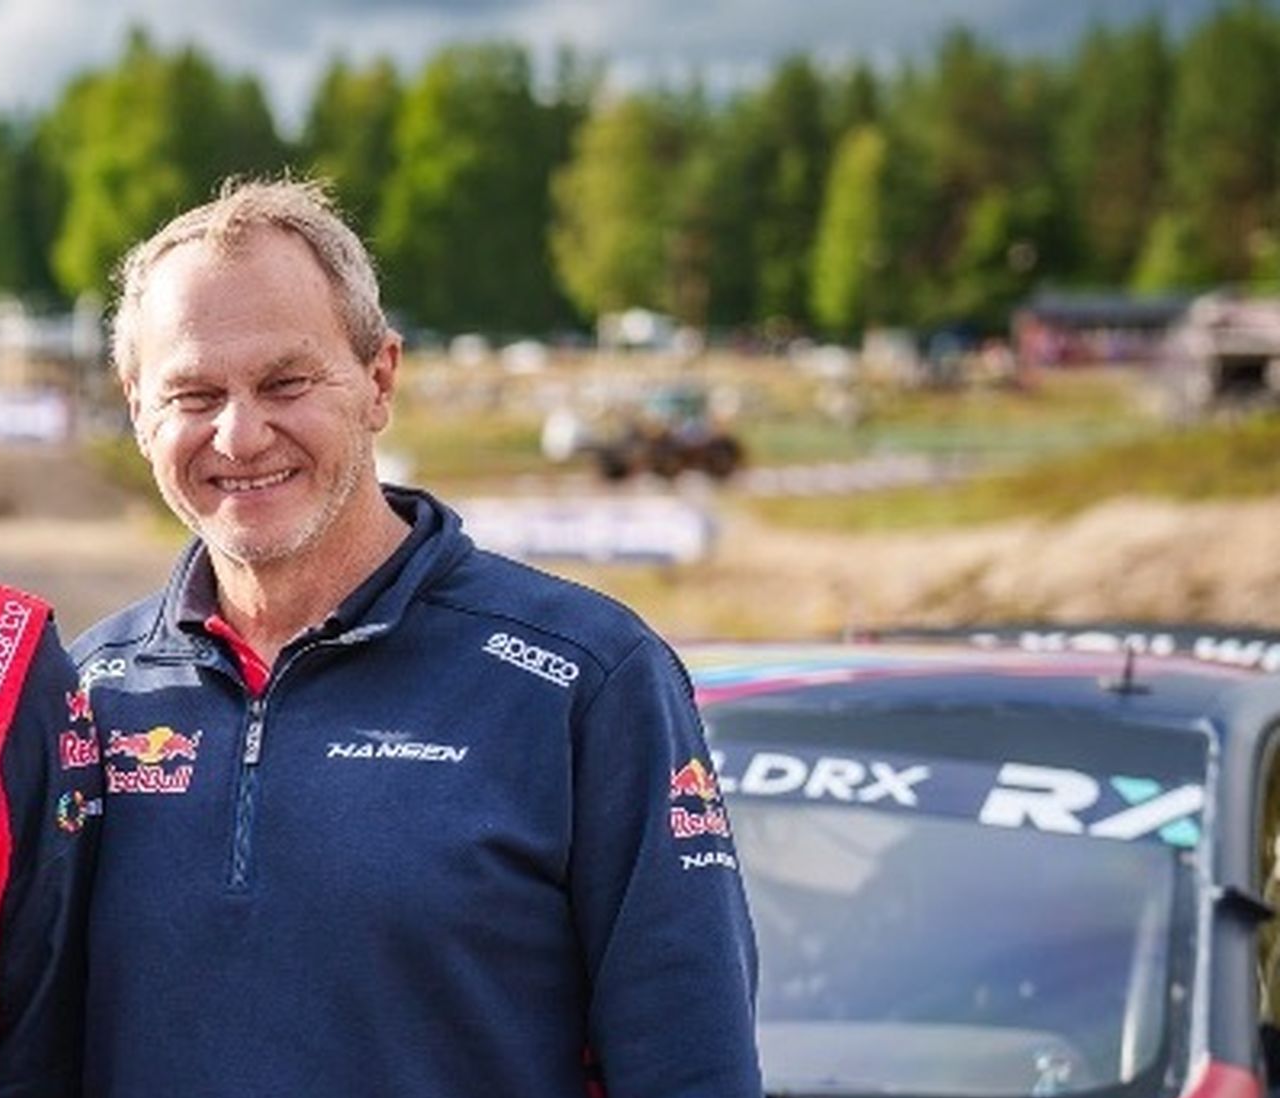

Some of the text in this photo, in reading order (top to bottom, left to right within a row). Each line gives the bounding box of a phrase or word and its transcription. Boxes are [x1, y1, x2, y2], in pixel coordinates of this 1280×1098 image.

[482, 632, 579, 688] sparco
[326, 742, 470, 763] HANSEN
[979, 761, 1205, 850] RX
